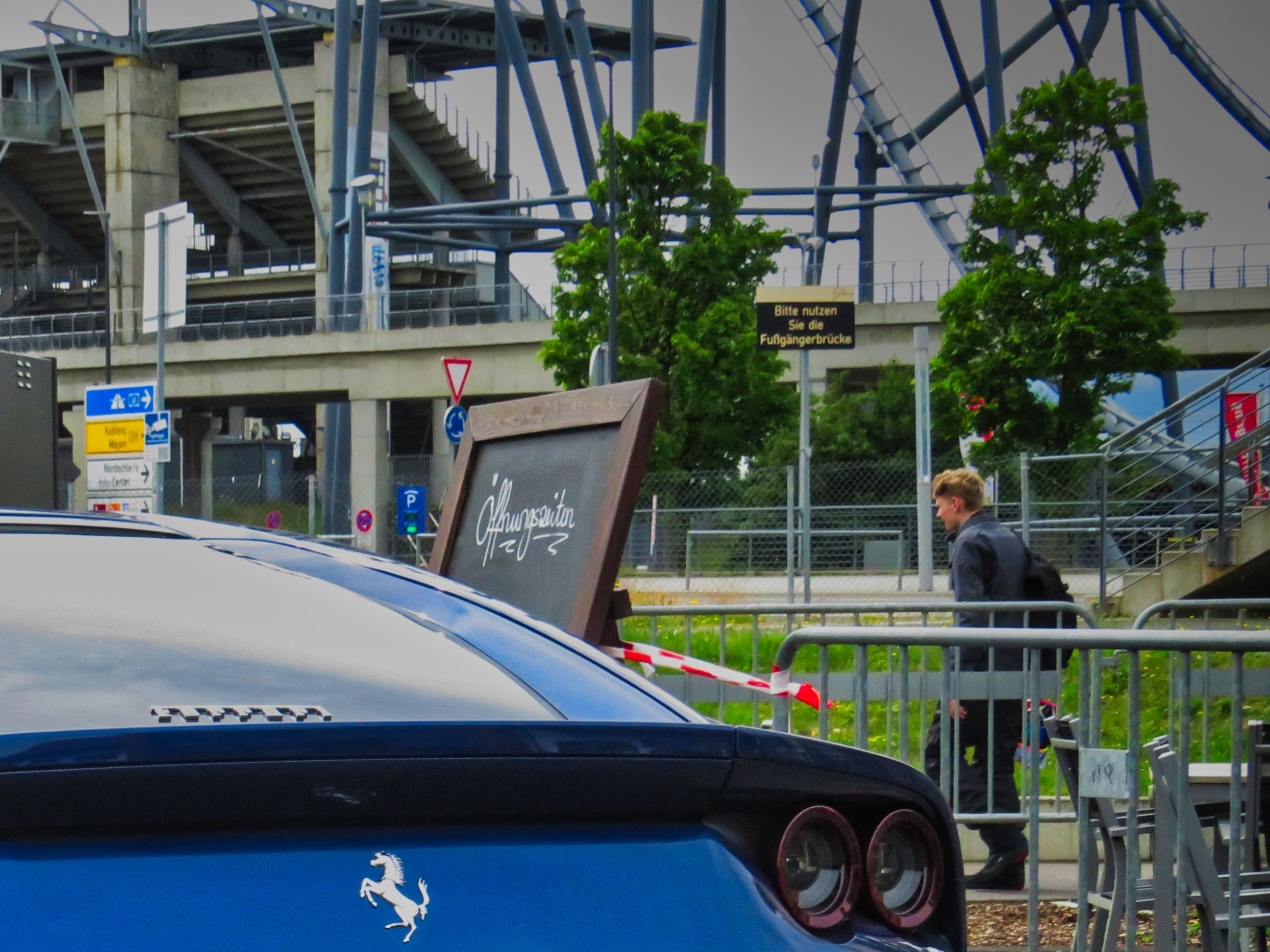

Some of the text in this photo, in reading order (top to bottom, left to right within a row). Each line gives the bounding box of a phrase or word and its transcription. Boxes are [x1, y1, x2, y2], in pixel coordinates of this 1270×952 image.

[774, 305, 838, 317] Bitte nutzen
[788, 319, 824, 331] Sie die
[759, 333, 853, 348] Fußgängerbrücke
[104, 425, 127, 436] Koblenz
[109, 440, 127, 451] Mayen
[103, 462, 139, 474] Nordschleife
